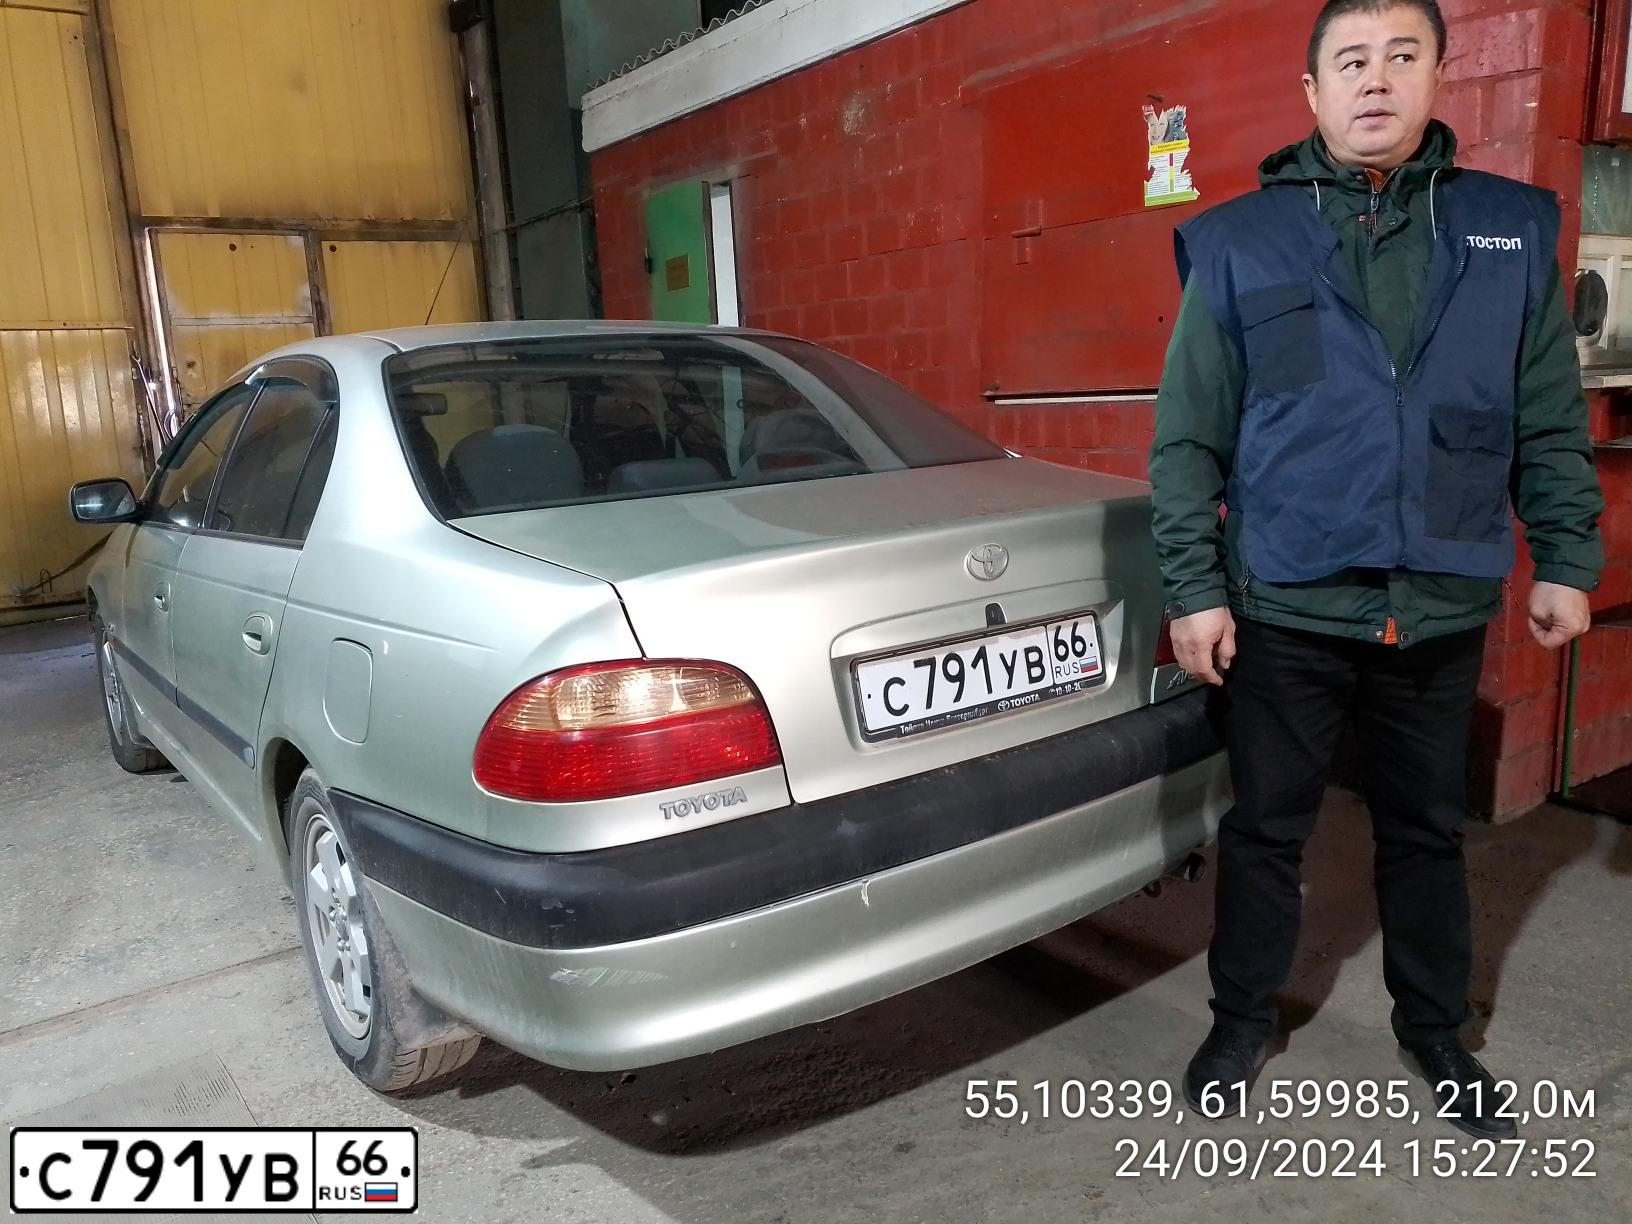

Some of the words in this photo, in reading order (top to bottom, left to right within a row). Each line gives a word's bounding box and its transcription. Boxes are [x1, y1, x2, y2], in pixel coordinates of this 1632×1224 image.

[1466, 235, 1522, 250] ТОСТОП
[883, 645, 1046, 717] С791УВ
[1053, 622, 1087, 662] 66
[1055, 662, 1080, 678] RUS
[1010, 693, 1040, 707] TOYOTA
[659, 786, 747, 820] TOYOTA
